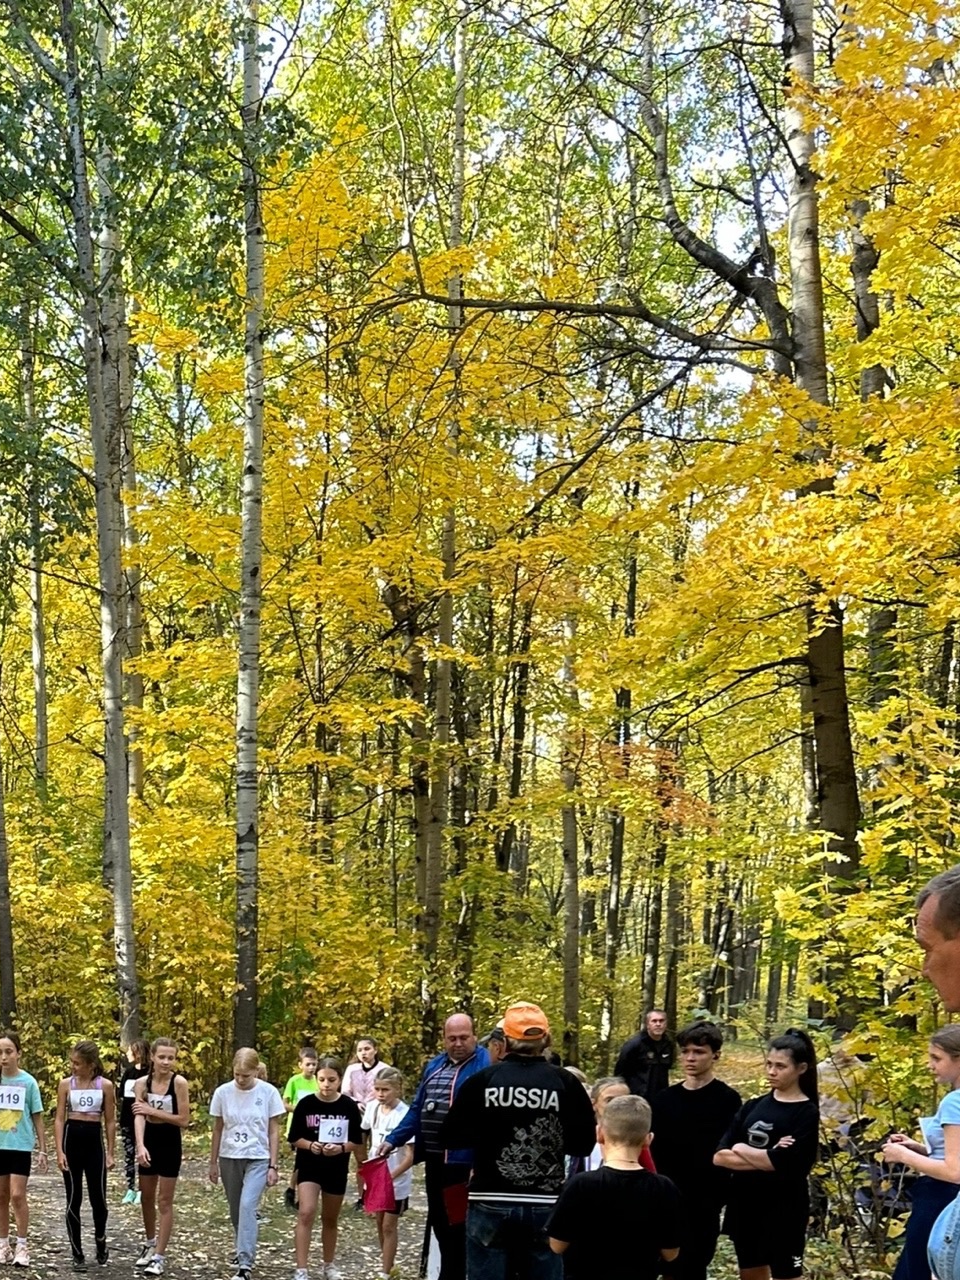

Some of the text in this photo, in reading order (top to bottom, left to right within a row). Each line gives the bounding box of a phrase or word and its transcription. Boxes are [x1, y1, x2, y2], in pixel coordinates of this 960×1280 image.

[0, 1093, 20, 1105] 119
[79, 1096, 94, 1107] 69
[485, 1087, 560, 1112] RUSSIA
[234, 1132, 249, 1144] 33
[327, 1127, 343, 1138] 43
